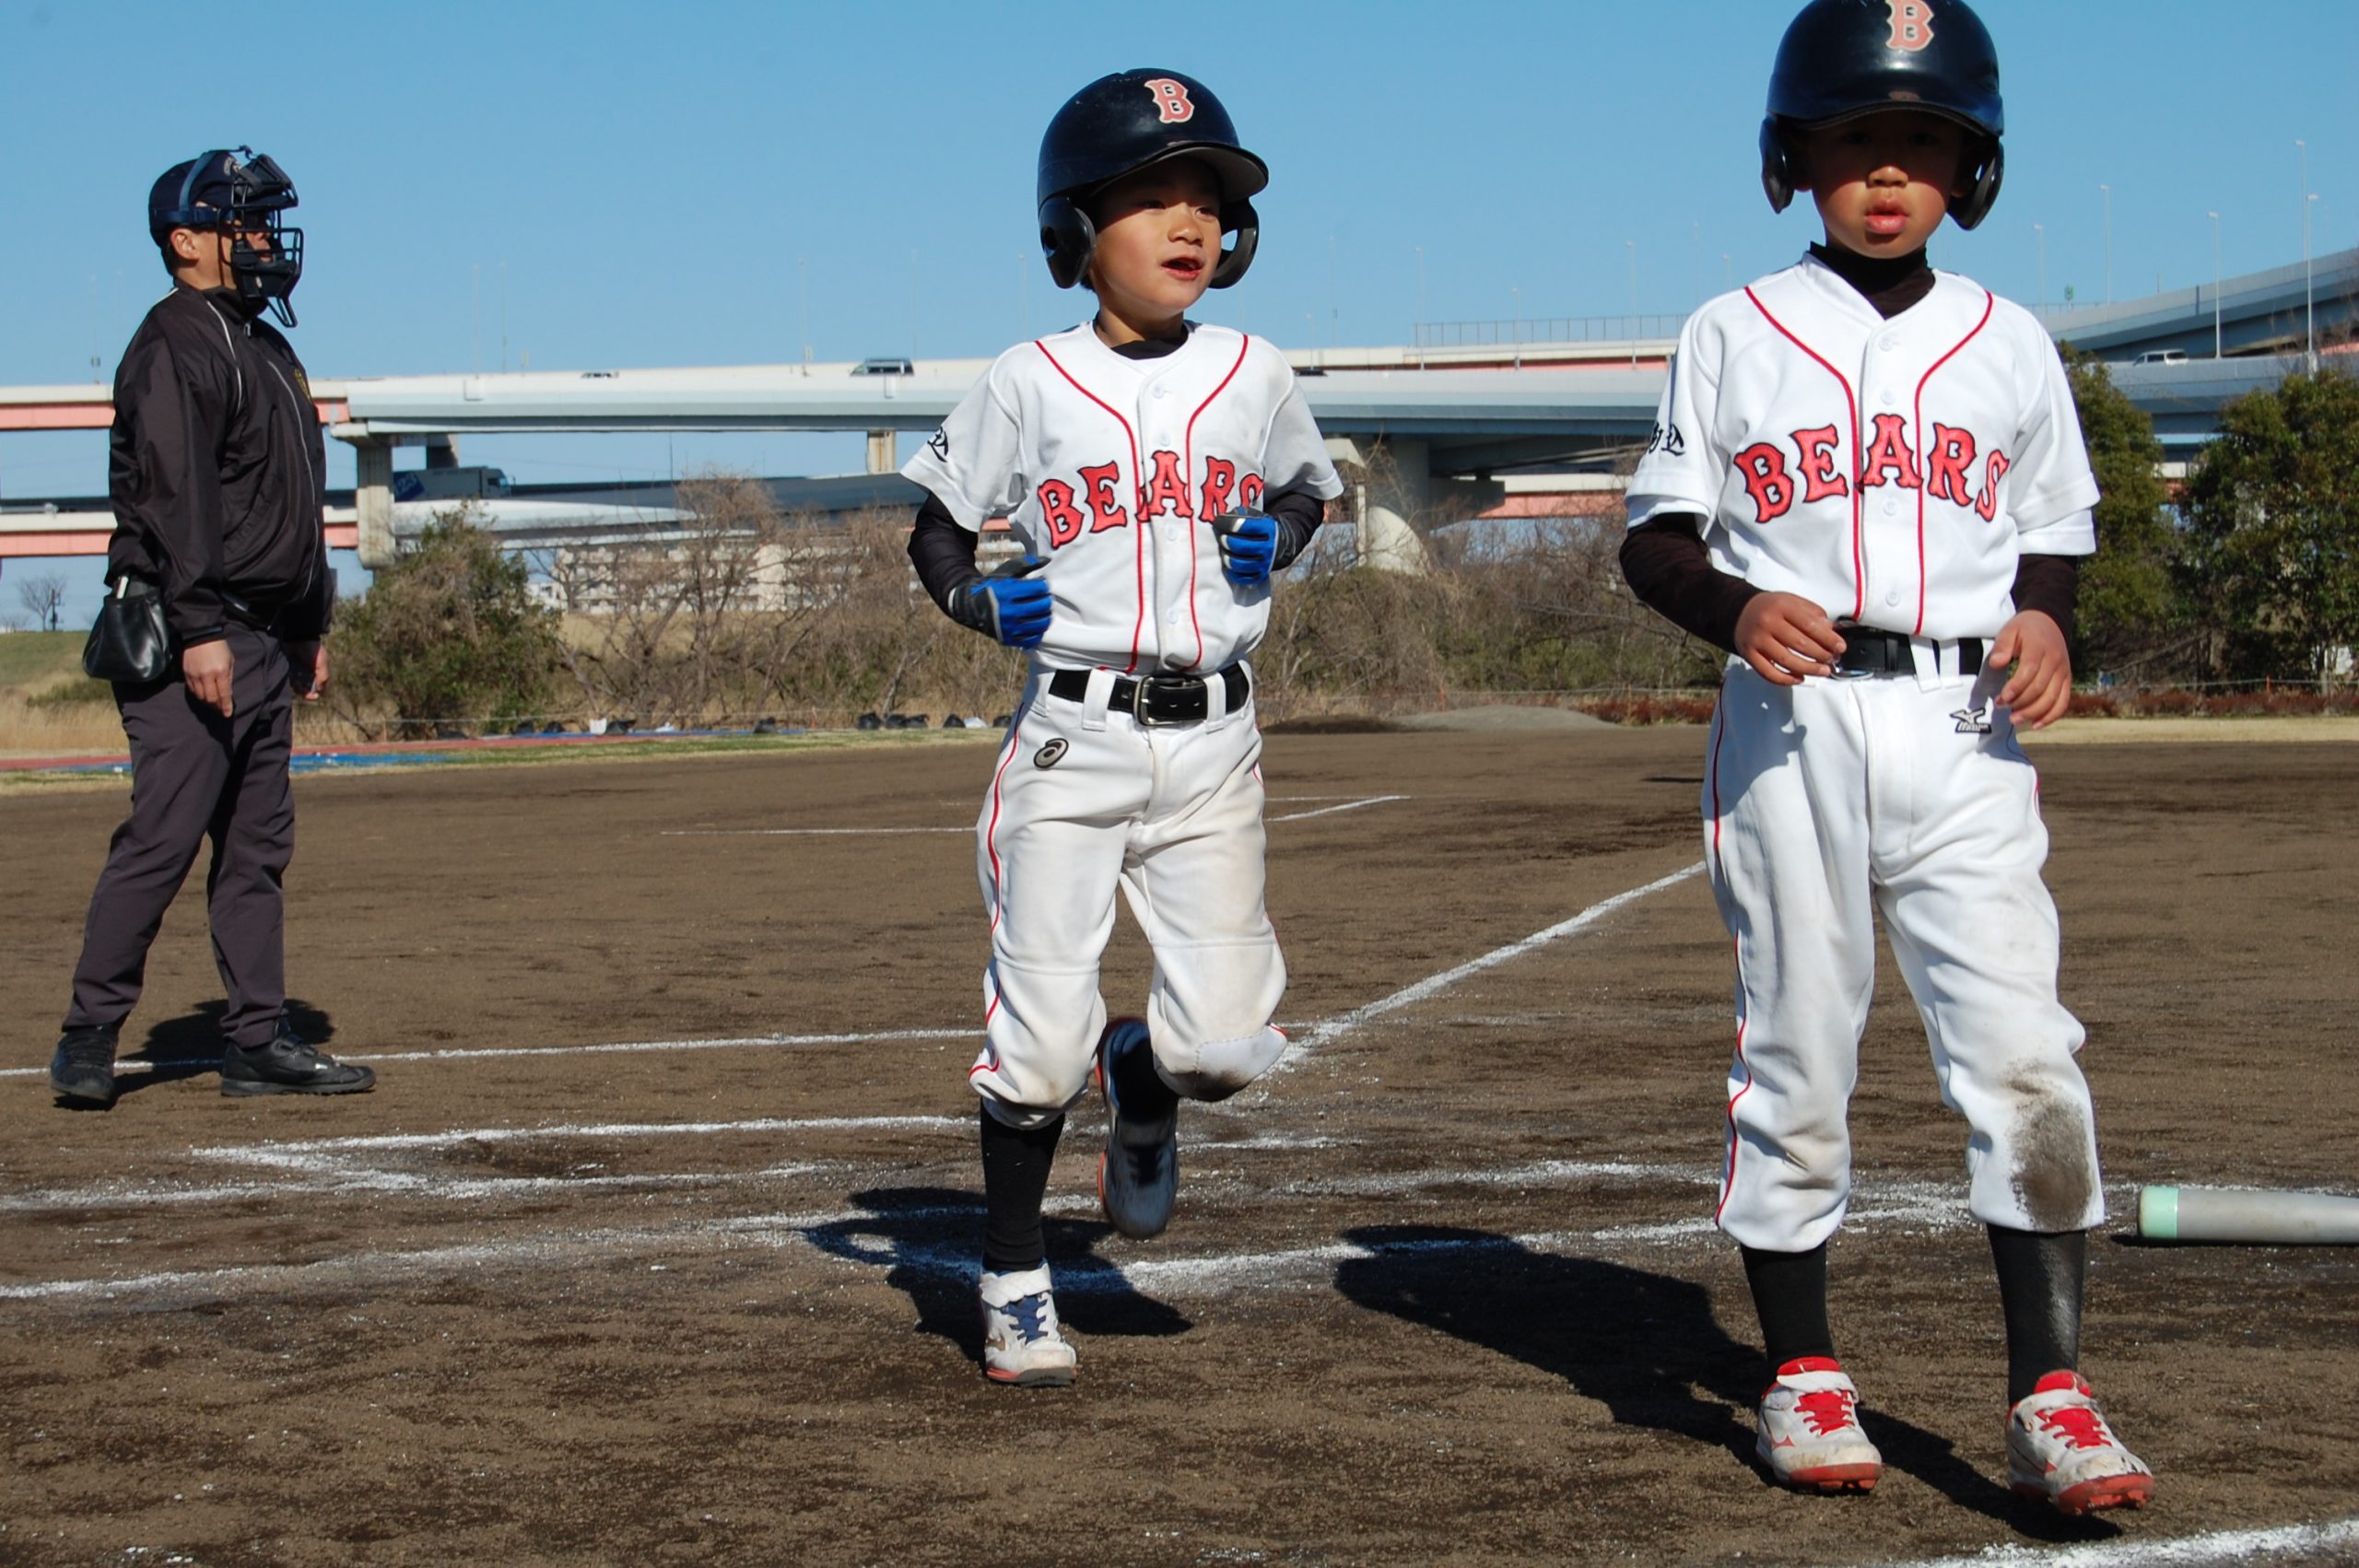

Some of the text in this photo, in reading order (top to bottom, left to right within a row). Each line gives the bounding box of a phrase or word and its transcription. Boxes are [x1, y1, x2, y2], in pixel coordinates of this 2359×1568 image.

[1885, 0, 1934, 52] B
[1144, 78, 1194, 123] B
[1733, 414, 2010, 523] BEARS
